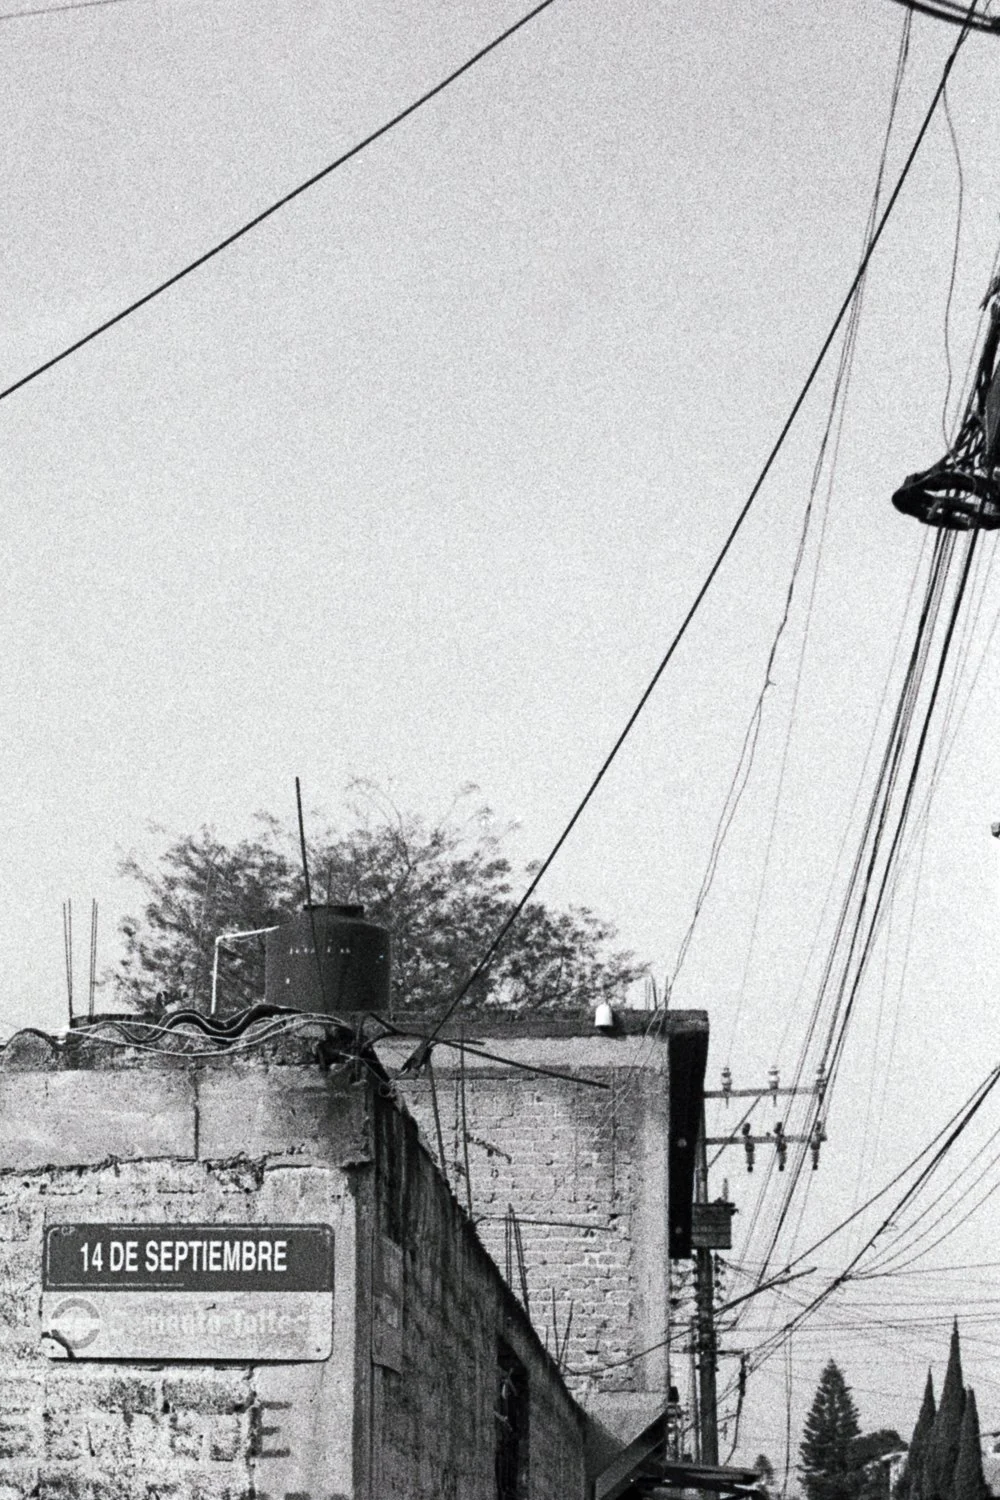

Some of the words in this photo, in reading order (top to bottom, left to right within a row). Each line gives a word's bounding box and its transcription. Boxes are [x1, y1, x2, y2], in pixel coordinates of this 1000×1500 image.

[81, 1242, 104, 1272] 14
[110, 1241, 139, 1272] DE
[145, 1240, 288, 1272] SEPTIEMBRE
